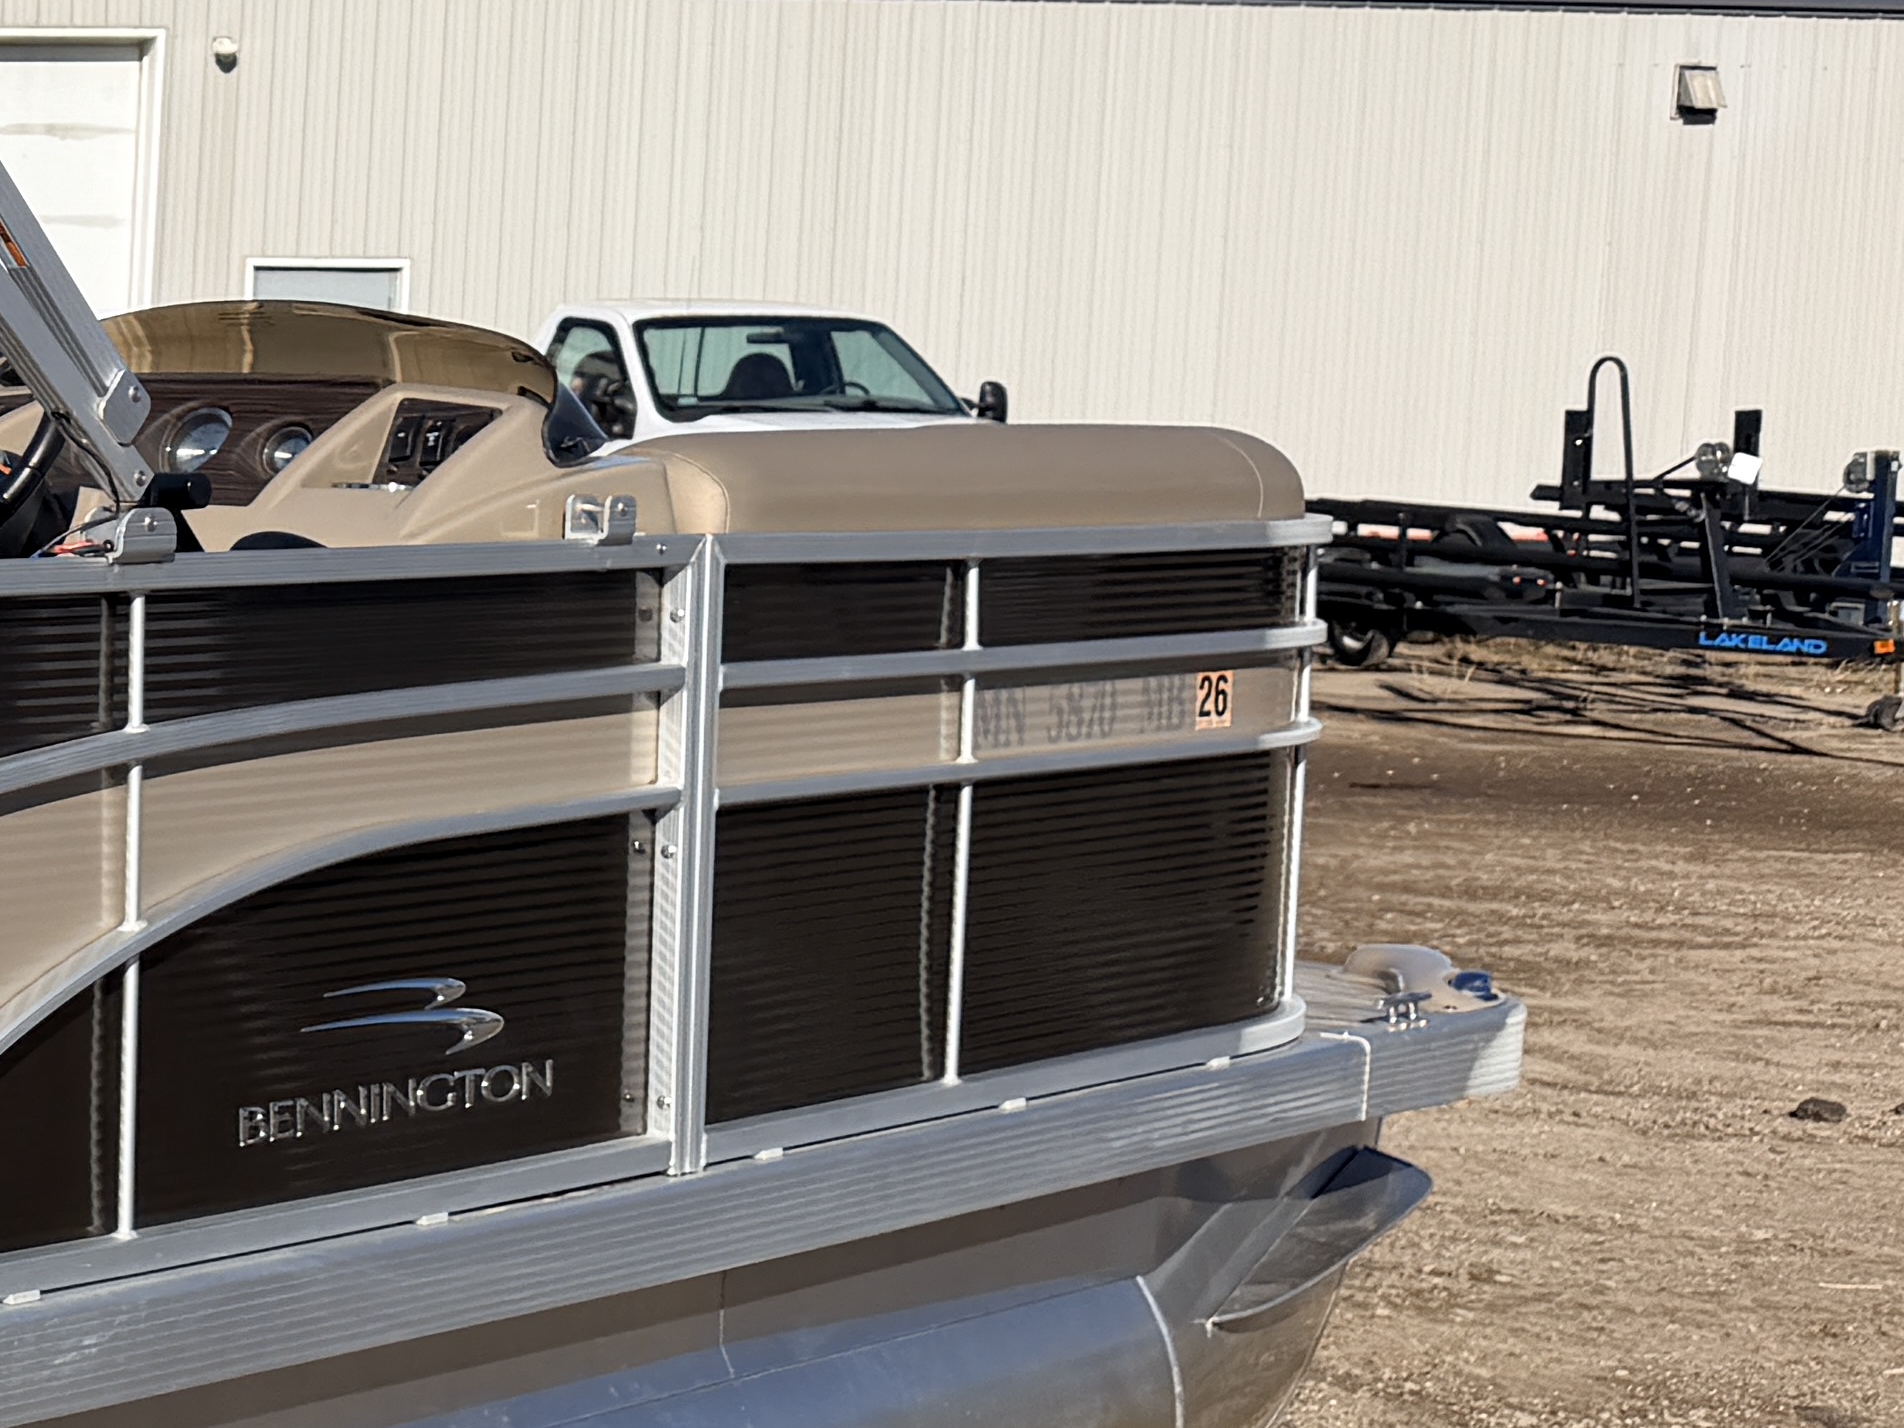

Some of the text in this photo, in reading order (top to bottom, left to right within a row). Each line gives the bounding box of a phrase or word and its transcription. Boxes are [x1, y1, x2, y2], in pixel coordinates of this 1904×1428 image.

[1698, 631, 1828, 654] LAKELAND
[1198, 675, 1229, 718] 26
[238, 1059, 554, 1147] BENNINGTON
